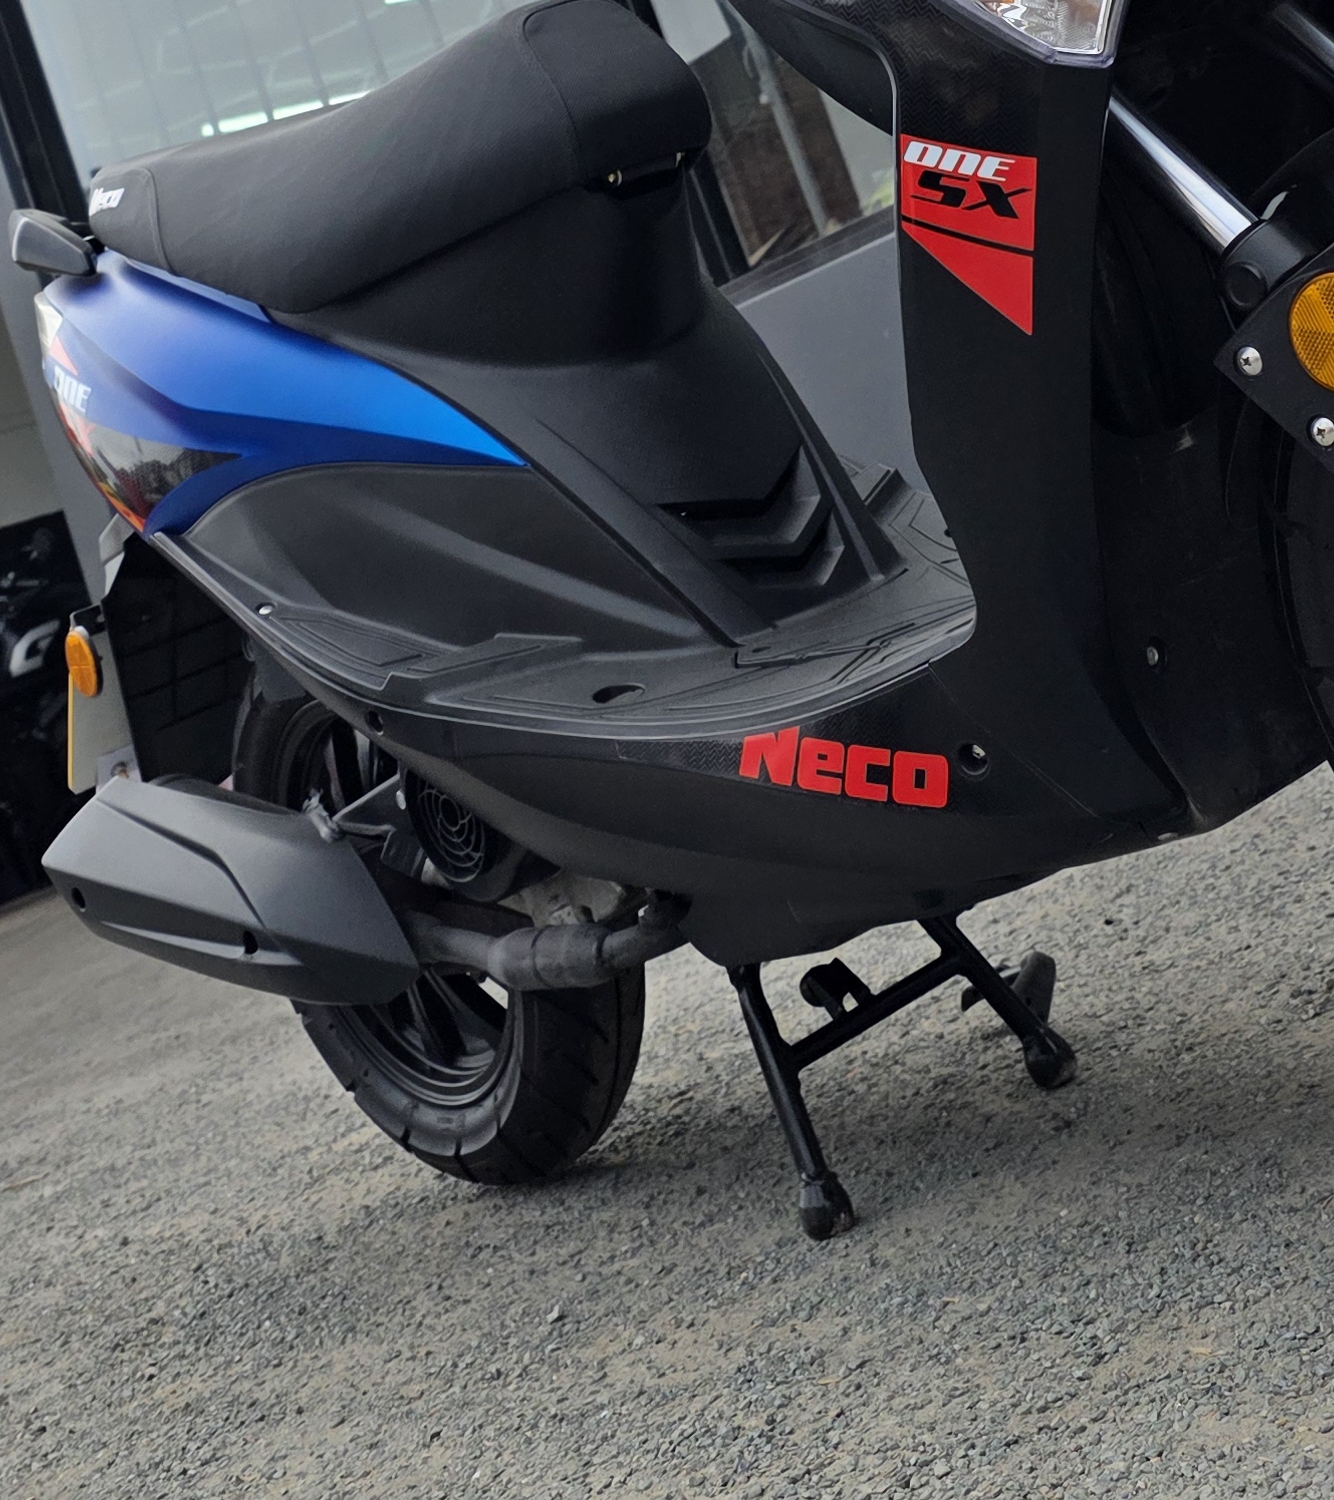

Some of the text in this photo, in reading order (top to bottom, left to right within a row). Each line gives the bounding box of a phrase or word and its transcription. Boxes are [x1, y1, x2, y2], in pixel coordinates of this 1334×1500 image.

[903, 140, 1016, 182] ONE
[910, 169, 1033, 220] SX
[738, 726, 950, 809] Neco
